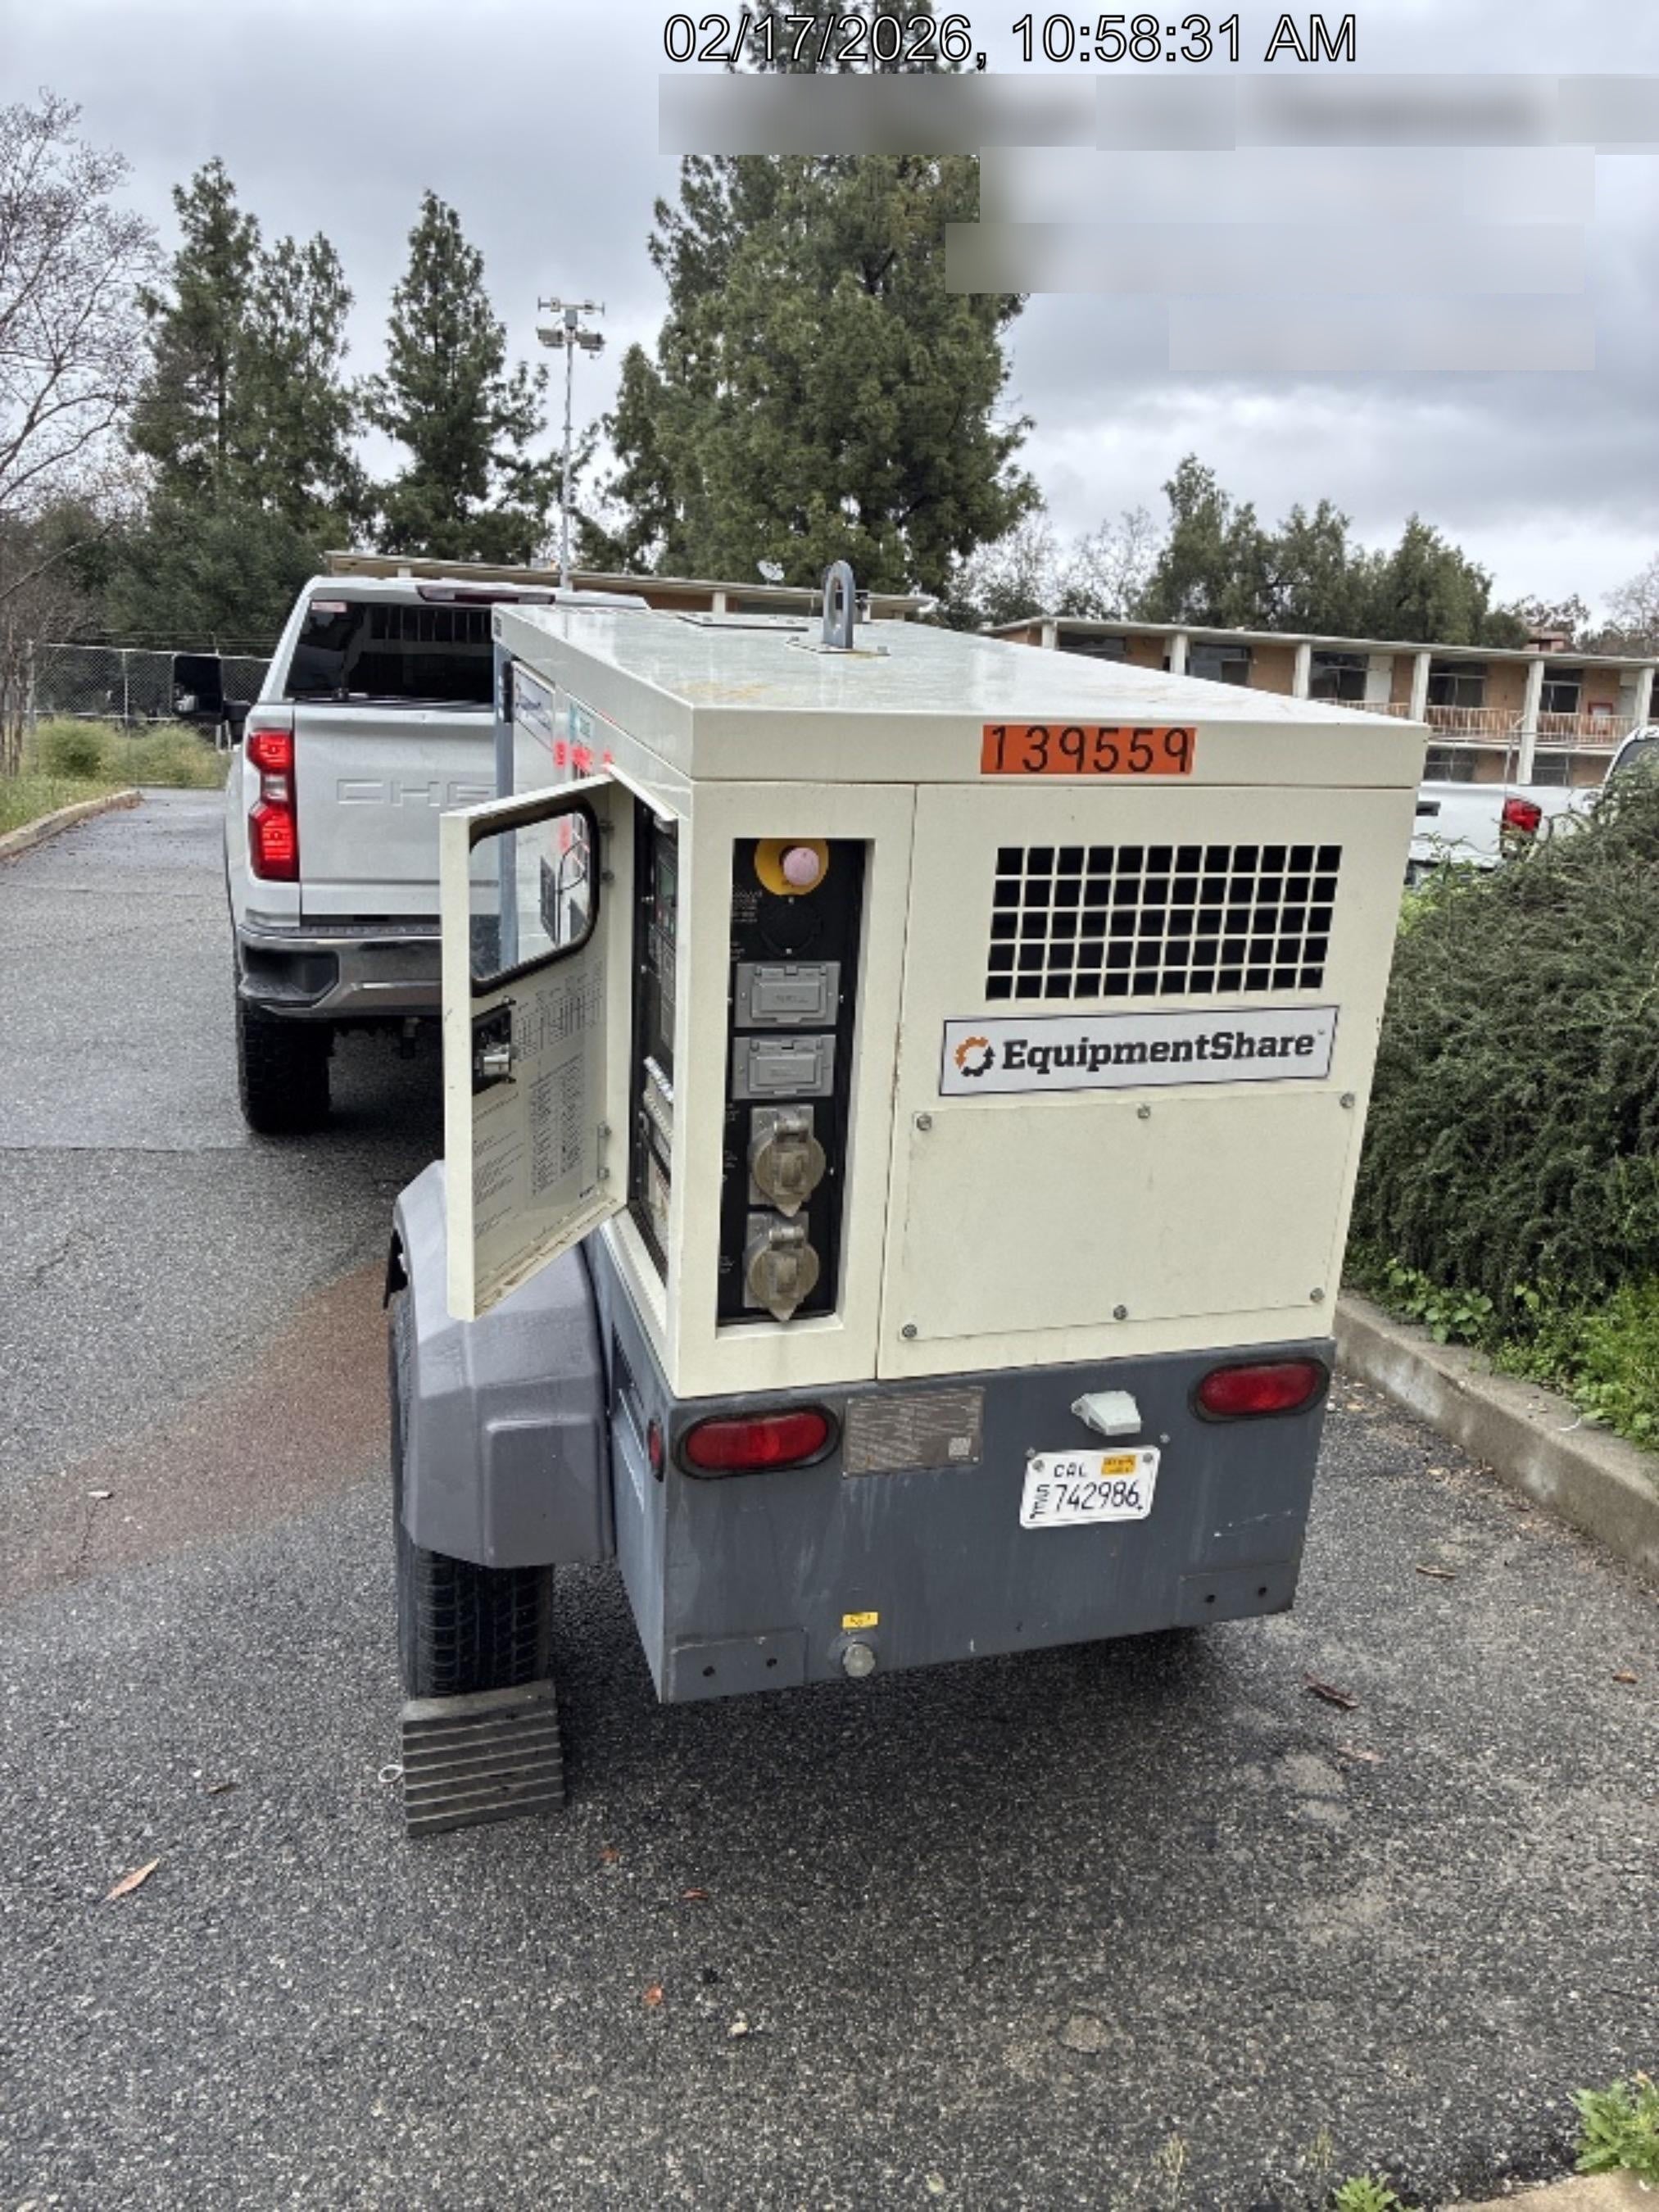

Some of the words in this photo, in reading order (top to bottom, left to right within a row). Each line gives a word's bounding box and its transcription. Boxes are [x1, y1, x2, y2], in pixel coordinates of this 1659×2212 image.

[992, 725, 1188, 772] 139559
[1002, 1031, 1315, 1074] EquipmentShare
[1054, 1463, 1088, 1477] CAL
[1054, 1479, 1140, 1512] 742986
